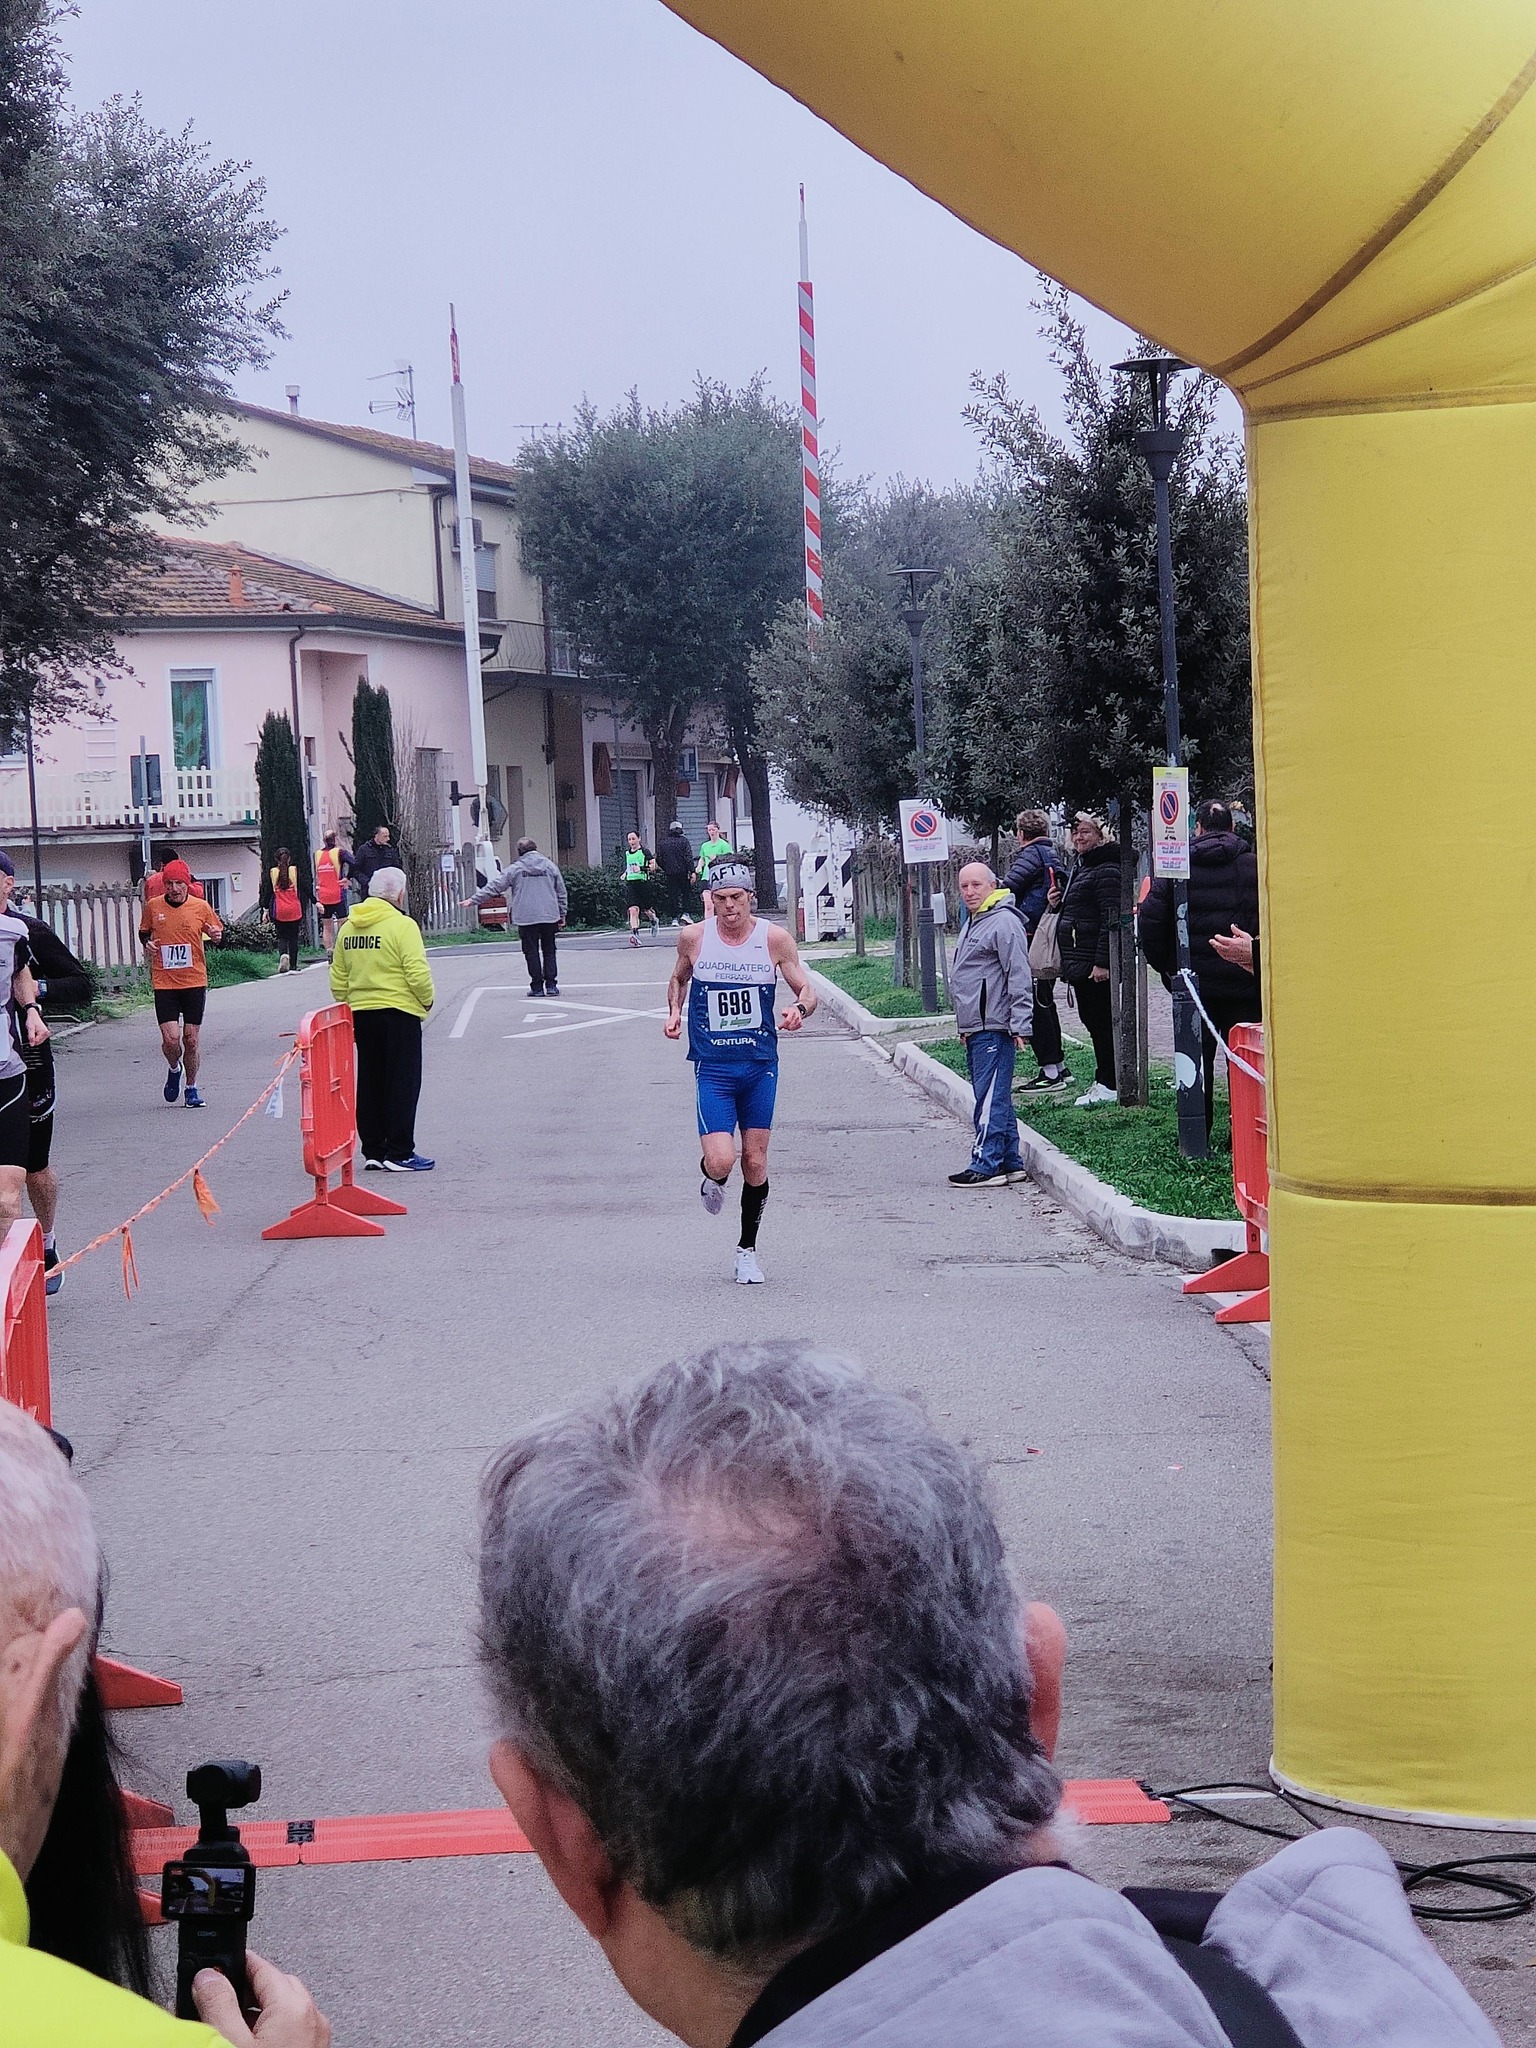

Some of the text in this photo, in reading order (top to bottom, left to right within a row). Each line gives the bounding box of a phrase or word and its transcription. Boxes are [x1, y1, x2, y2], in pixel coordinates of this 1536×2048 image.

[344, 935, 382, 950] GIUDICE
[168, 945, 187, 961] 712
[698, 961, 771, 973] QUADRILATERO
[715, 972, 753, 981] FERRARA
[717, 990, 752, 1017] 698
